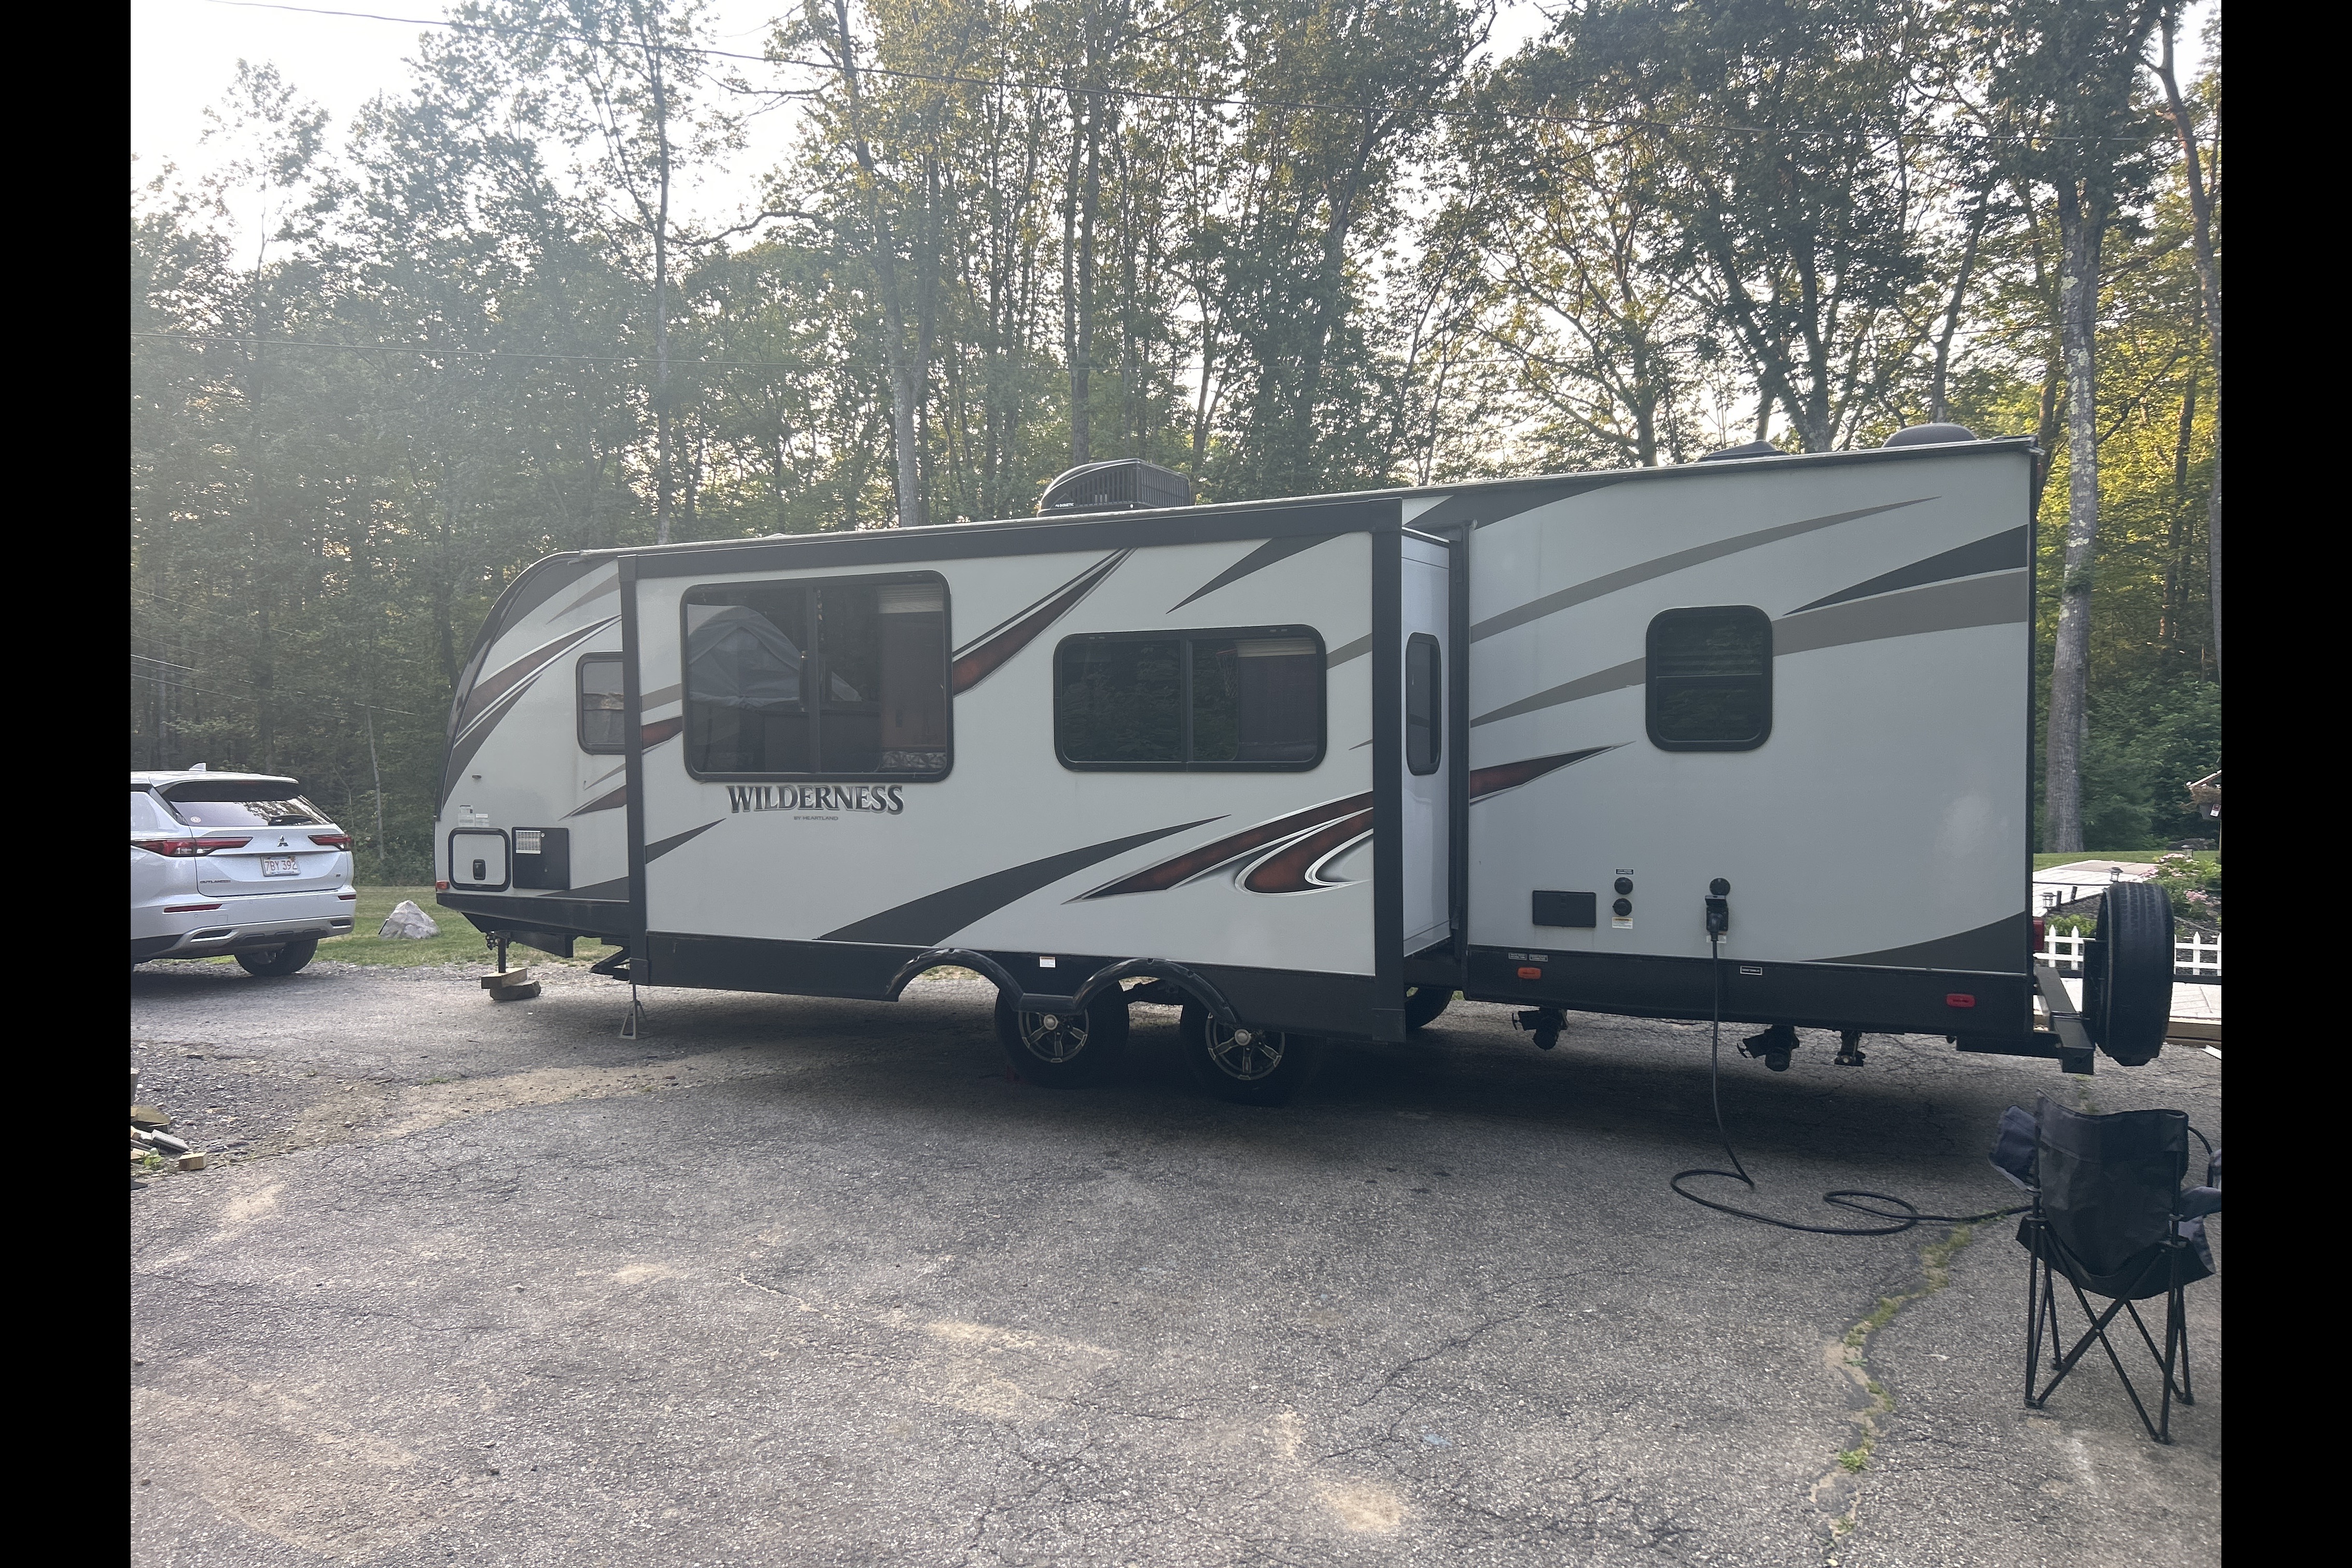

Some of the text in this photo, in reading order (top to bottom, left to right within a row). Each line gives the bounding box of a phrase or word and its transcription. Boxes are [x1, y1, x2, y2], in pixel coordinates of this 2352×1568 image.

[726, 785, 904, 815] WILDERNESS
[264, 860, 298, 871] 7BY 392
